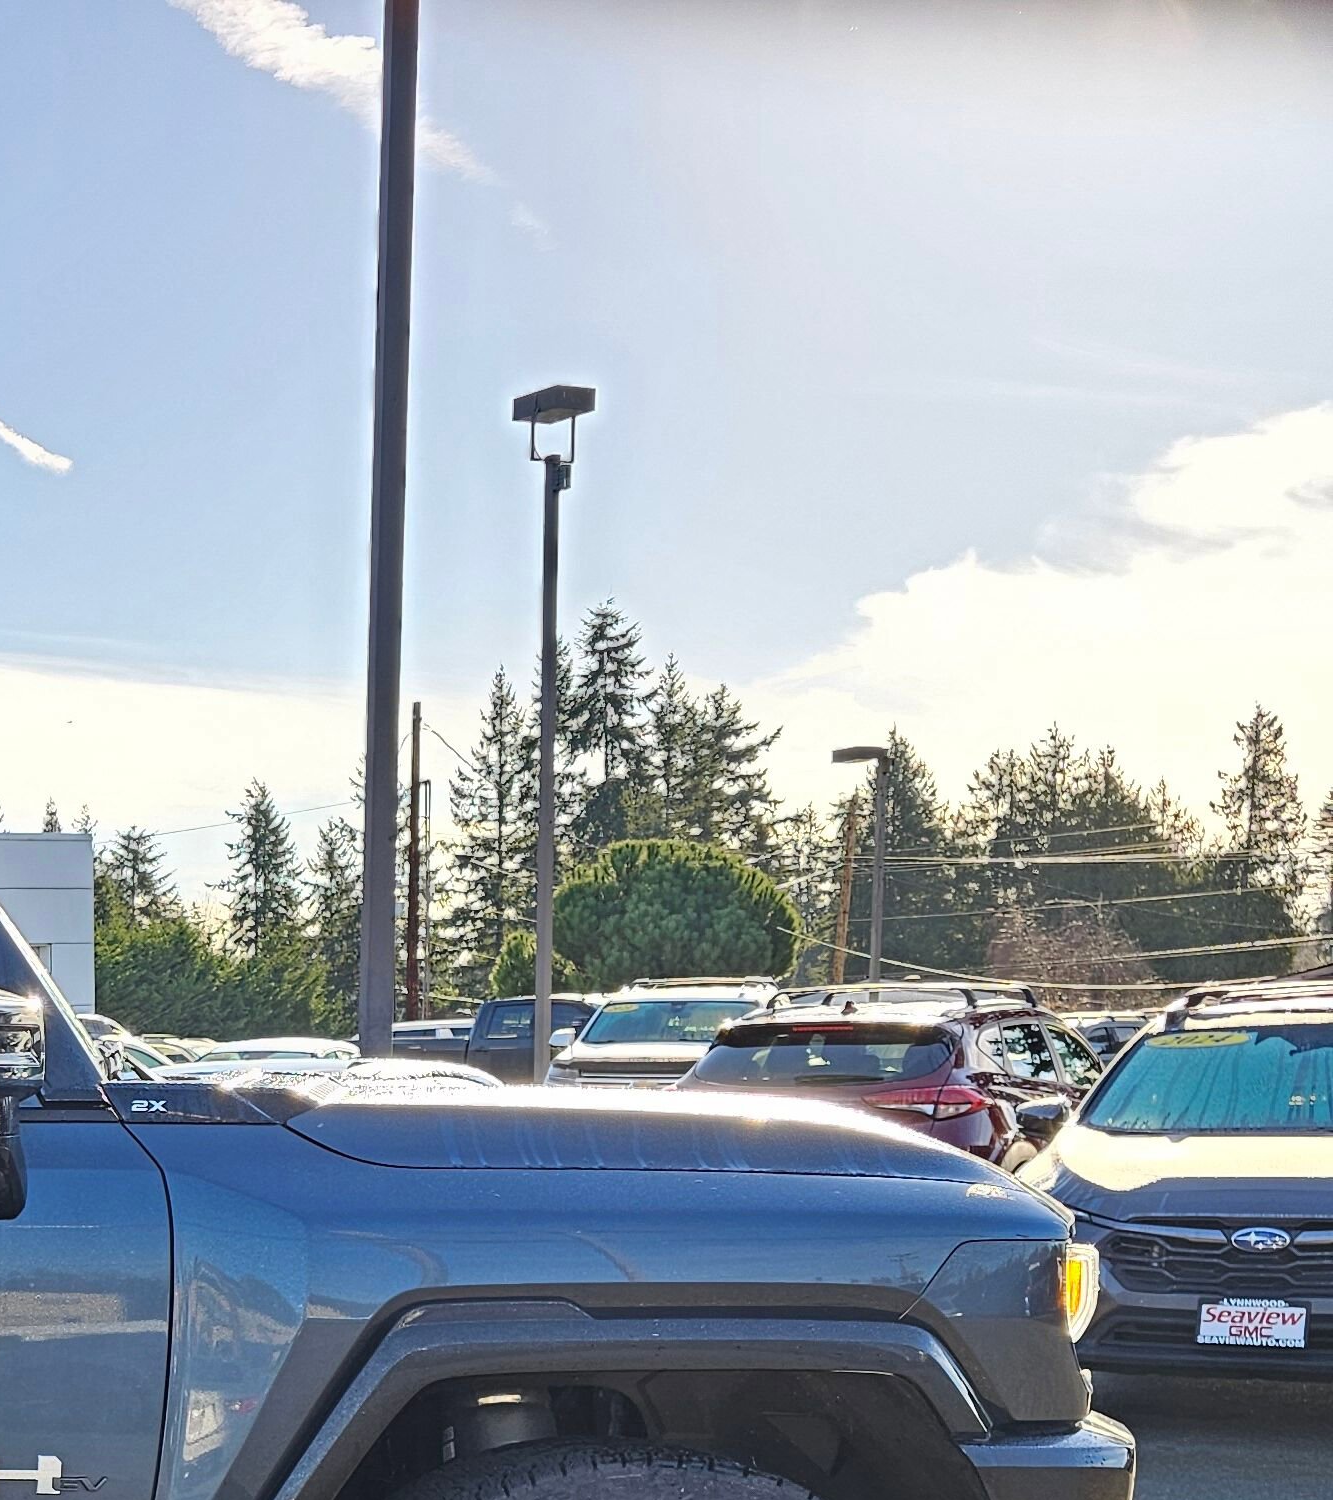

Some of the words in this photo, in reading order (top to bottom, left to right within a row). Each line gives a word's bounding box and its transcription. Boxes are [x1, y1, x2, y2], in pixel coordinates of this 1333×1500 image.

[131, 1099, 168, 1113] 2X
[1203, 1306, 1304, 1326] Seaview
[1228, 1325, 1275, 1339] GMC
[1196, 1335, 1305, 1349] SEAVIEWAUTO.COM
